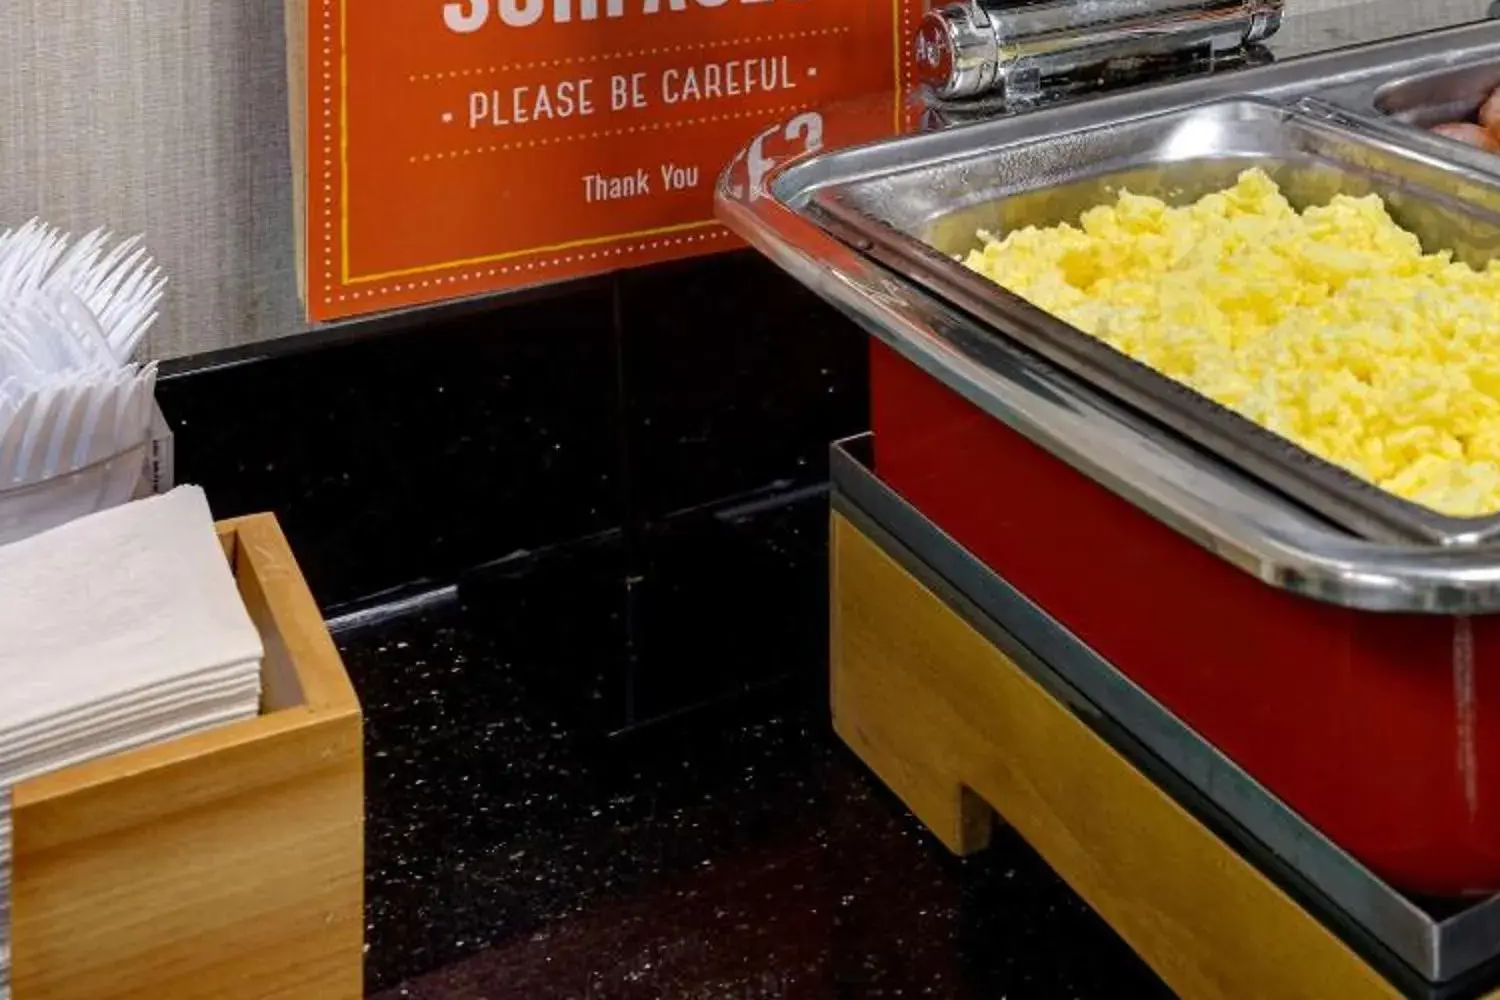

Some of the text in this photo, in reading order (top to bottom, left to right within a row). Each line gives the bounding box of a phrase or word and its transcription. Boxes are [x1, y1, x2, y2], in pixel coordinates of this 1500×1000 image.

[469, 55, 797, 129] PLEASE BE CAREFUL
[581, 163, 699, 203] Thank You
